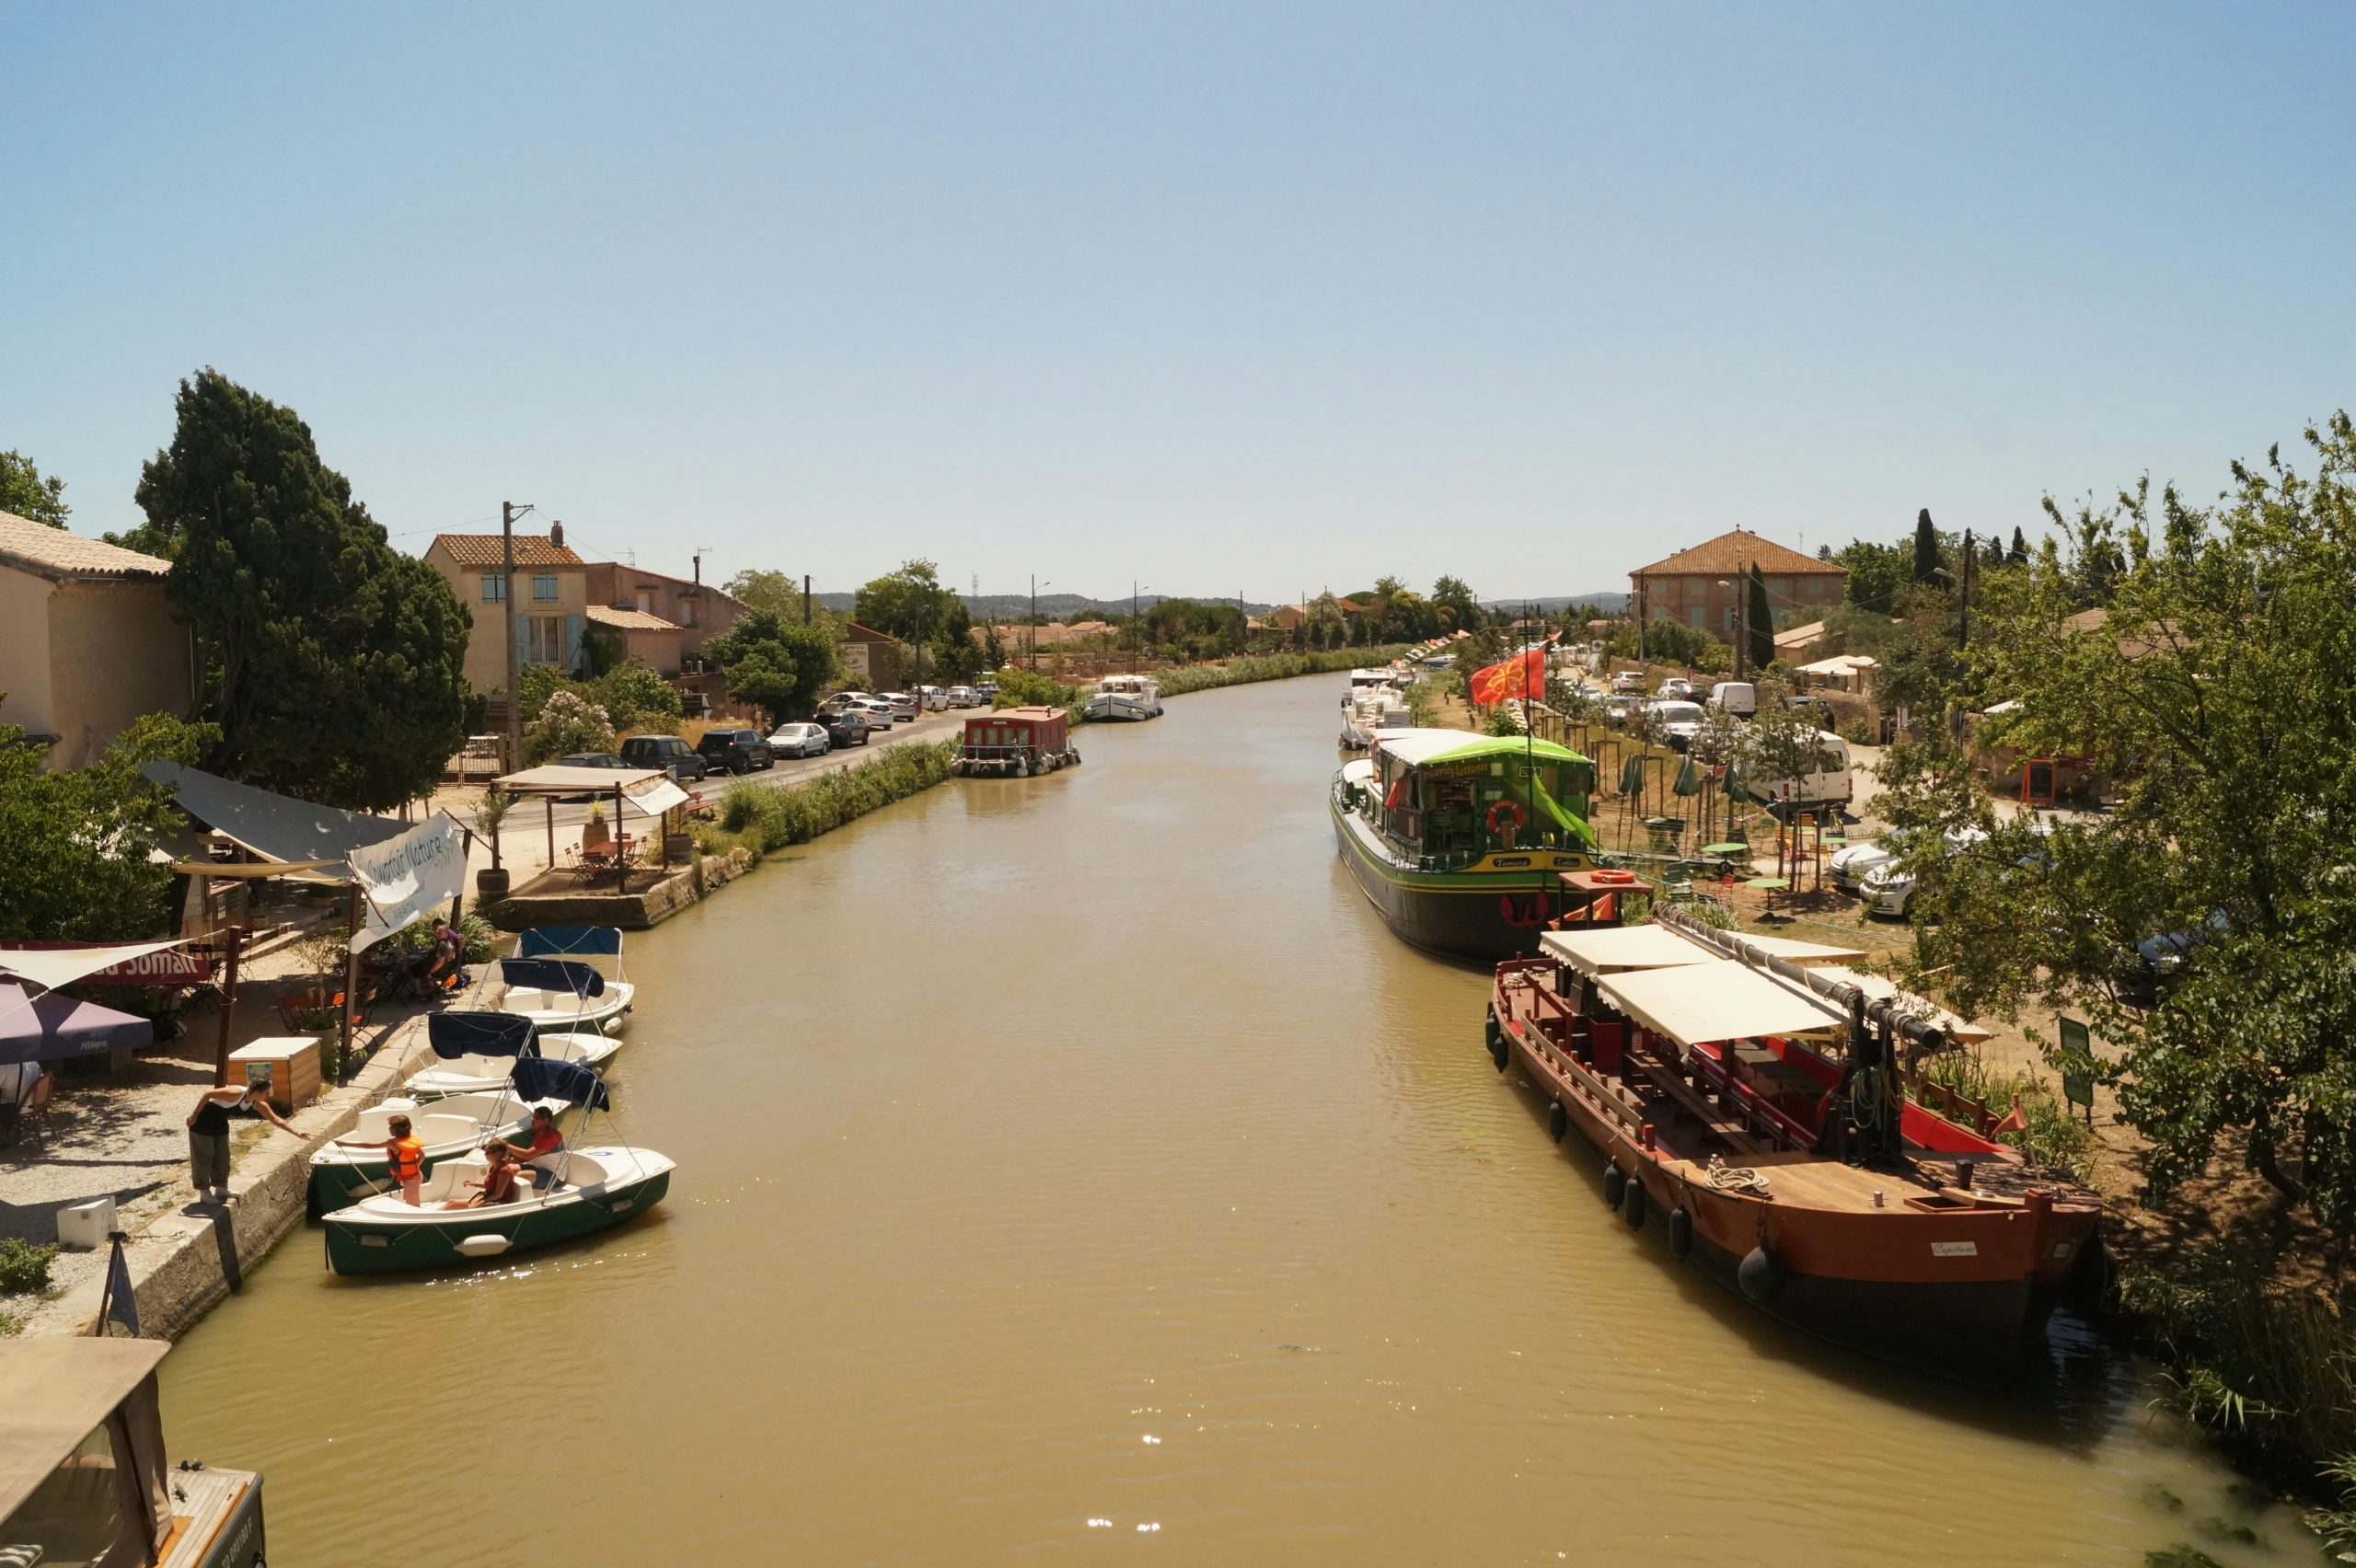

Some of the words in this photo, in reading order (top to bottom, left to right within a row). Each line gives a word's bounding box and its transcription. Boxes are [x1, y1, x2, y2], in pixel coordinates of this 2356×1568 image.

[368, 849, 405, 890] Comptoir
[406, 836, 443, 867] Nature
[125, 953, 198, 975] Somail
[248, 1517, 252, 1534] F
